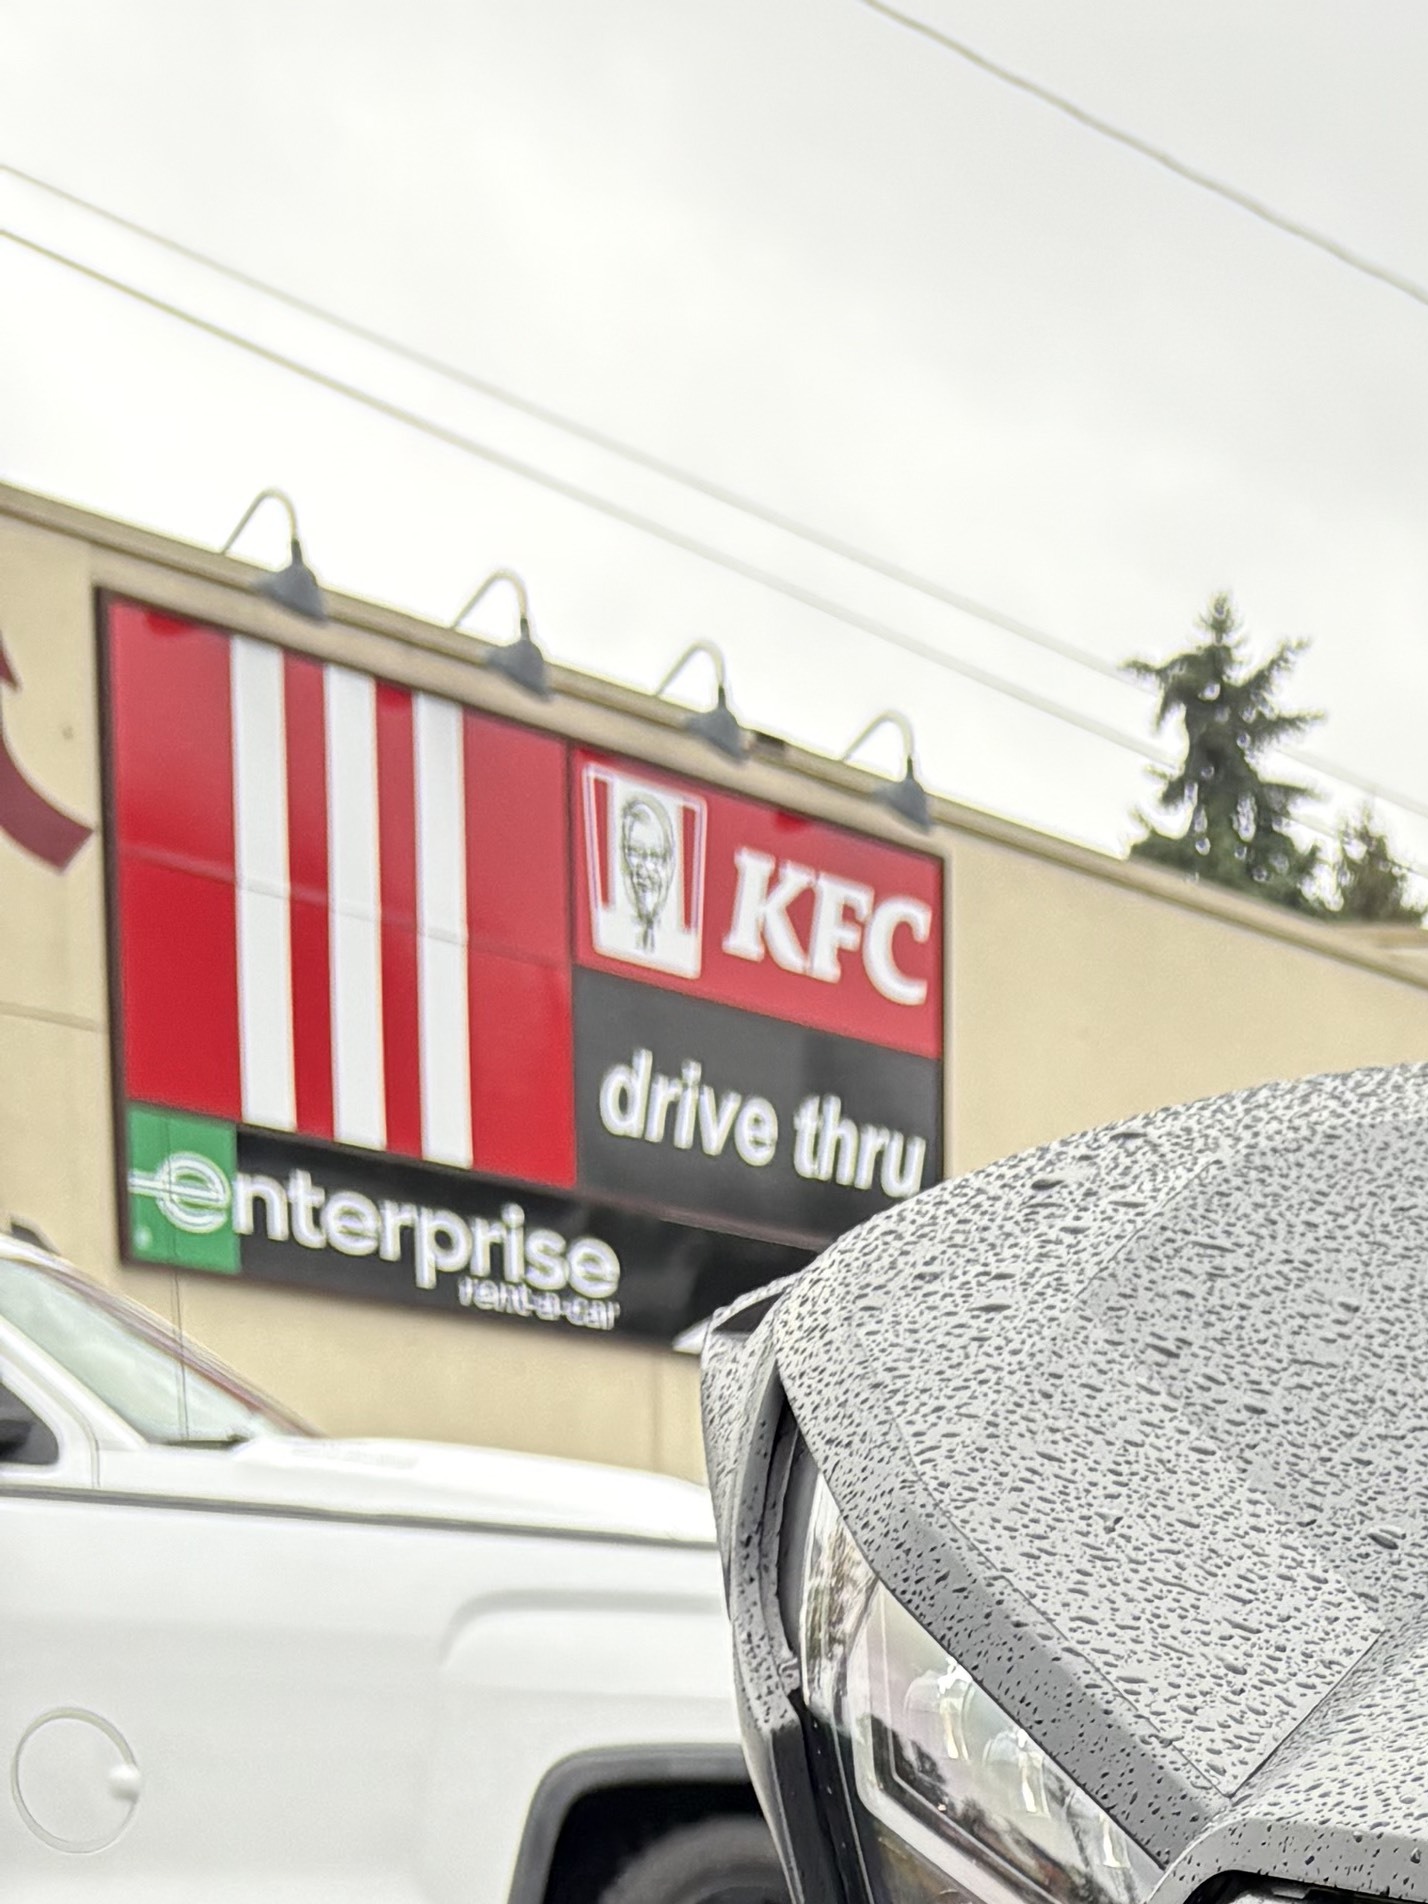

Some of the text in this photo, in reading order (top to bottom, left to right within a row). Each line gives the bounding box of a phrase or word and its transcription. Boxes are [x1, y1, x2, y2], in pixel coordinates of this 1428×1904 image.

[721, 845, 933, 1007] KFC
[598, 1047, 927, 1199] drive thru
[129, 1151, 621, 1298] enterprise
